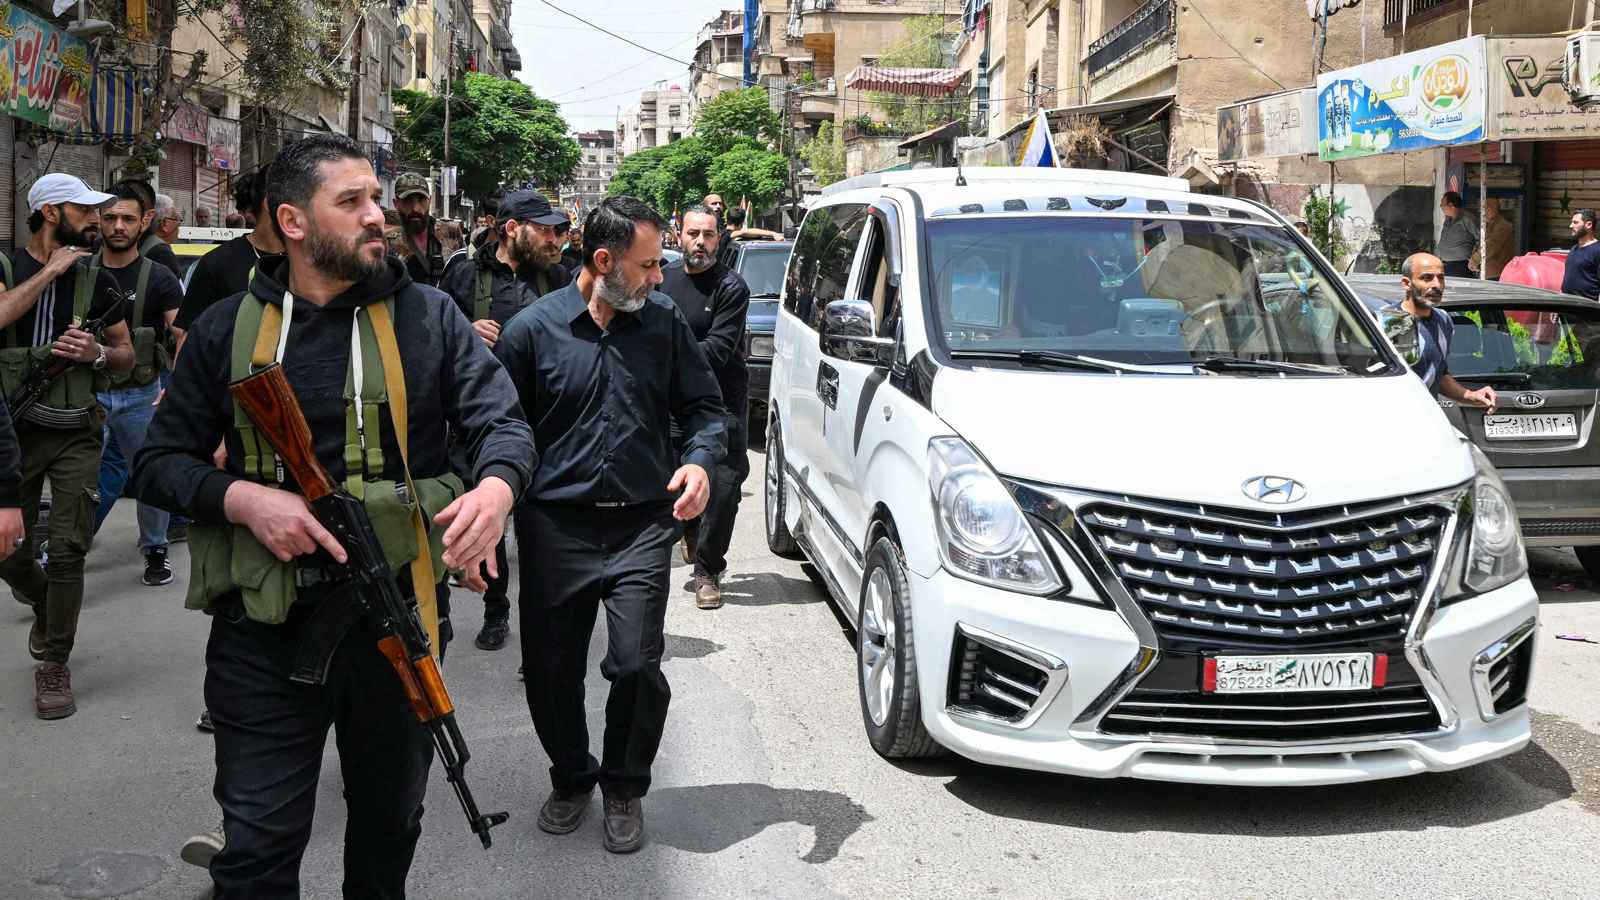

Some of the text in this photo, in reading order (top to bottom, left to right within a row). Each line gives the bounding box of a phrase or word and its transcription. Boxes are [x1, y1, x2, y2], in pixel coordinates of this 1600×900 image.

[1531, 416, 1575, 433] ٣١٩٣٠٩
[1297, 659, 1370, 687] ٨٧٥٢٢٨
[1219, 676, 1273, 689] 875228
